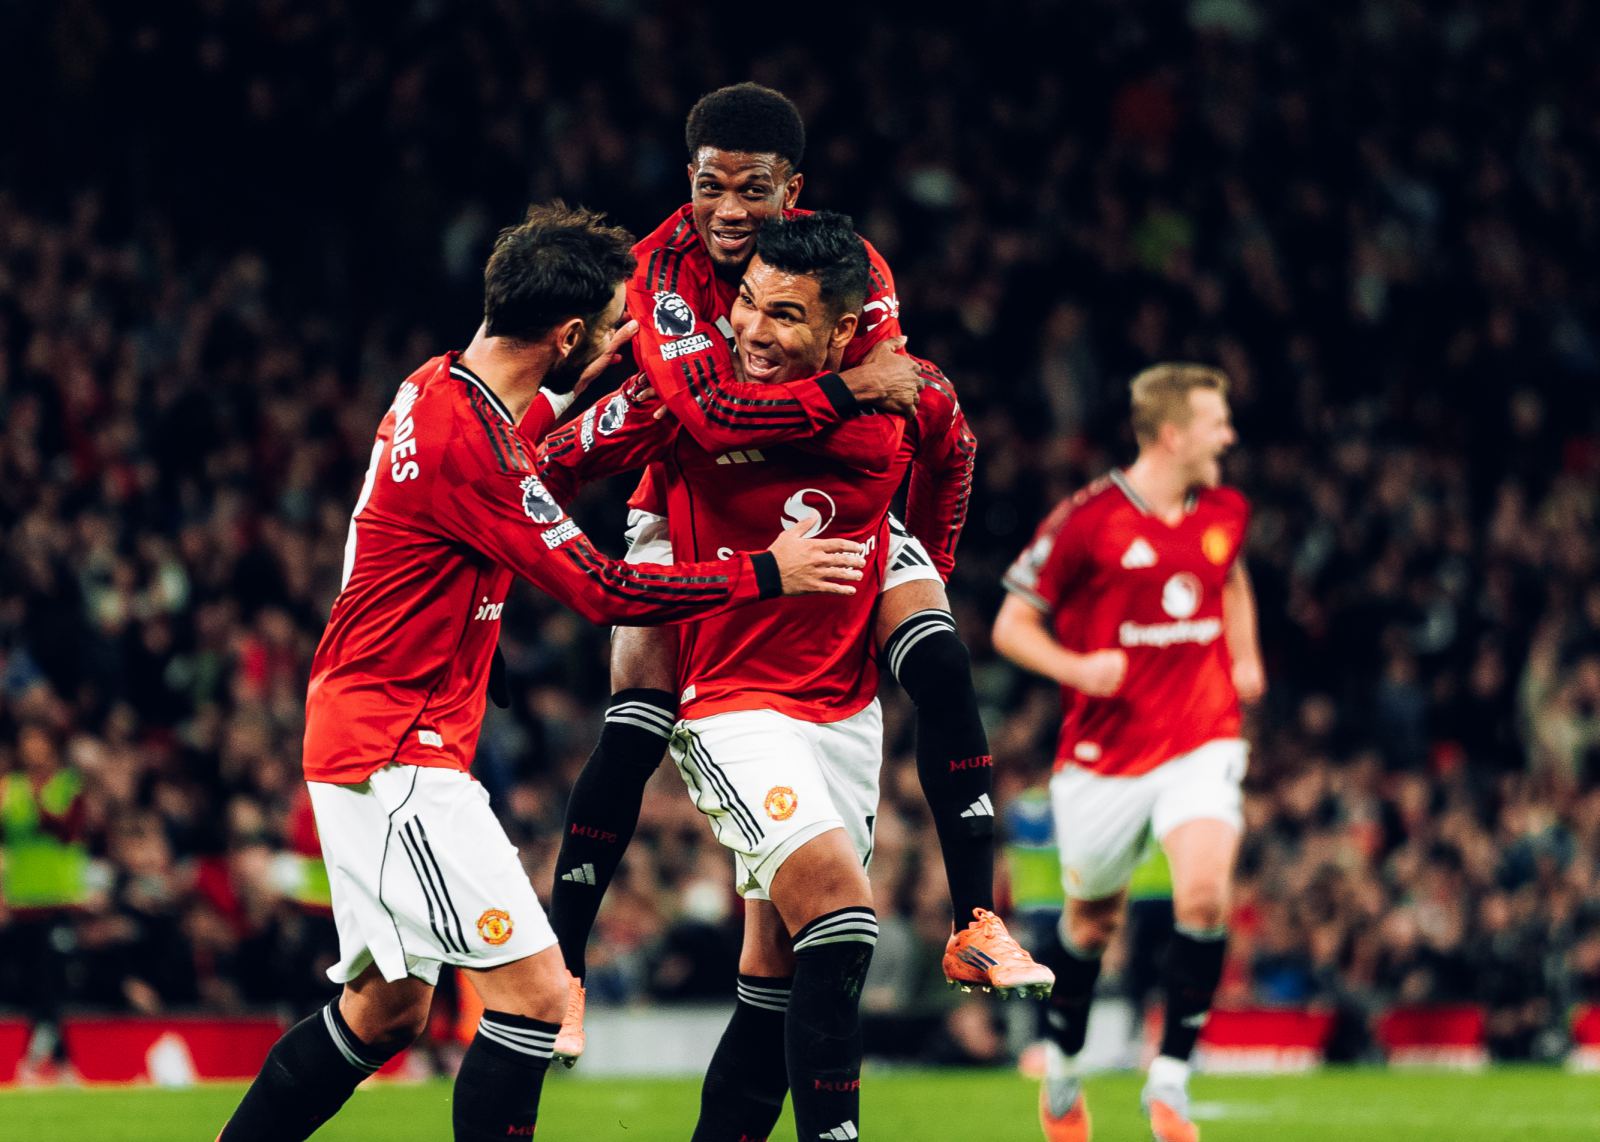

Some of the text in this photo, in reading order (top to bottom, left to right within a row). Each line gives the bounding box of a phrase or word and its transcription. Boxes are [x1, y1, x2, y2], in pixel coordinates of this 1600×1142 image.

[659, 333, 706, 353] No room
[948, 754, 993, 773] MUF
[814, 1079, 861, 1092] MUF
